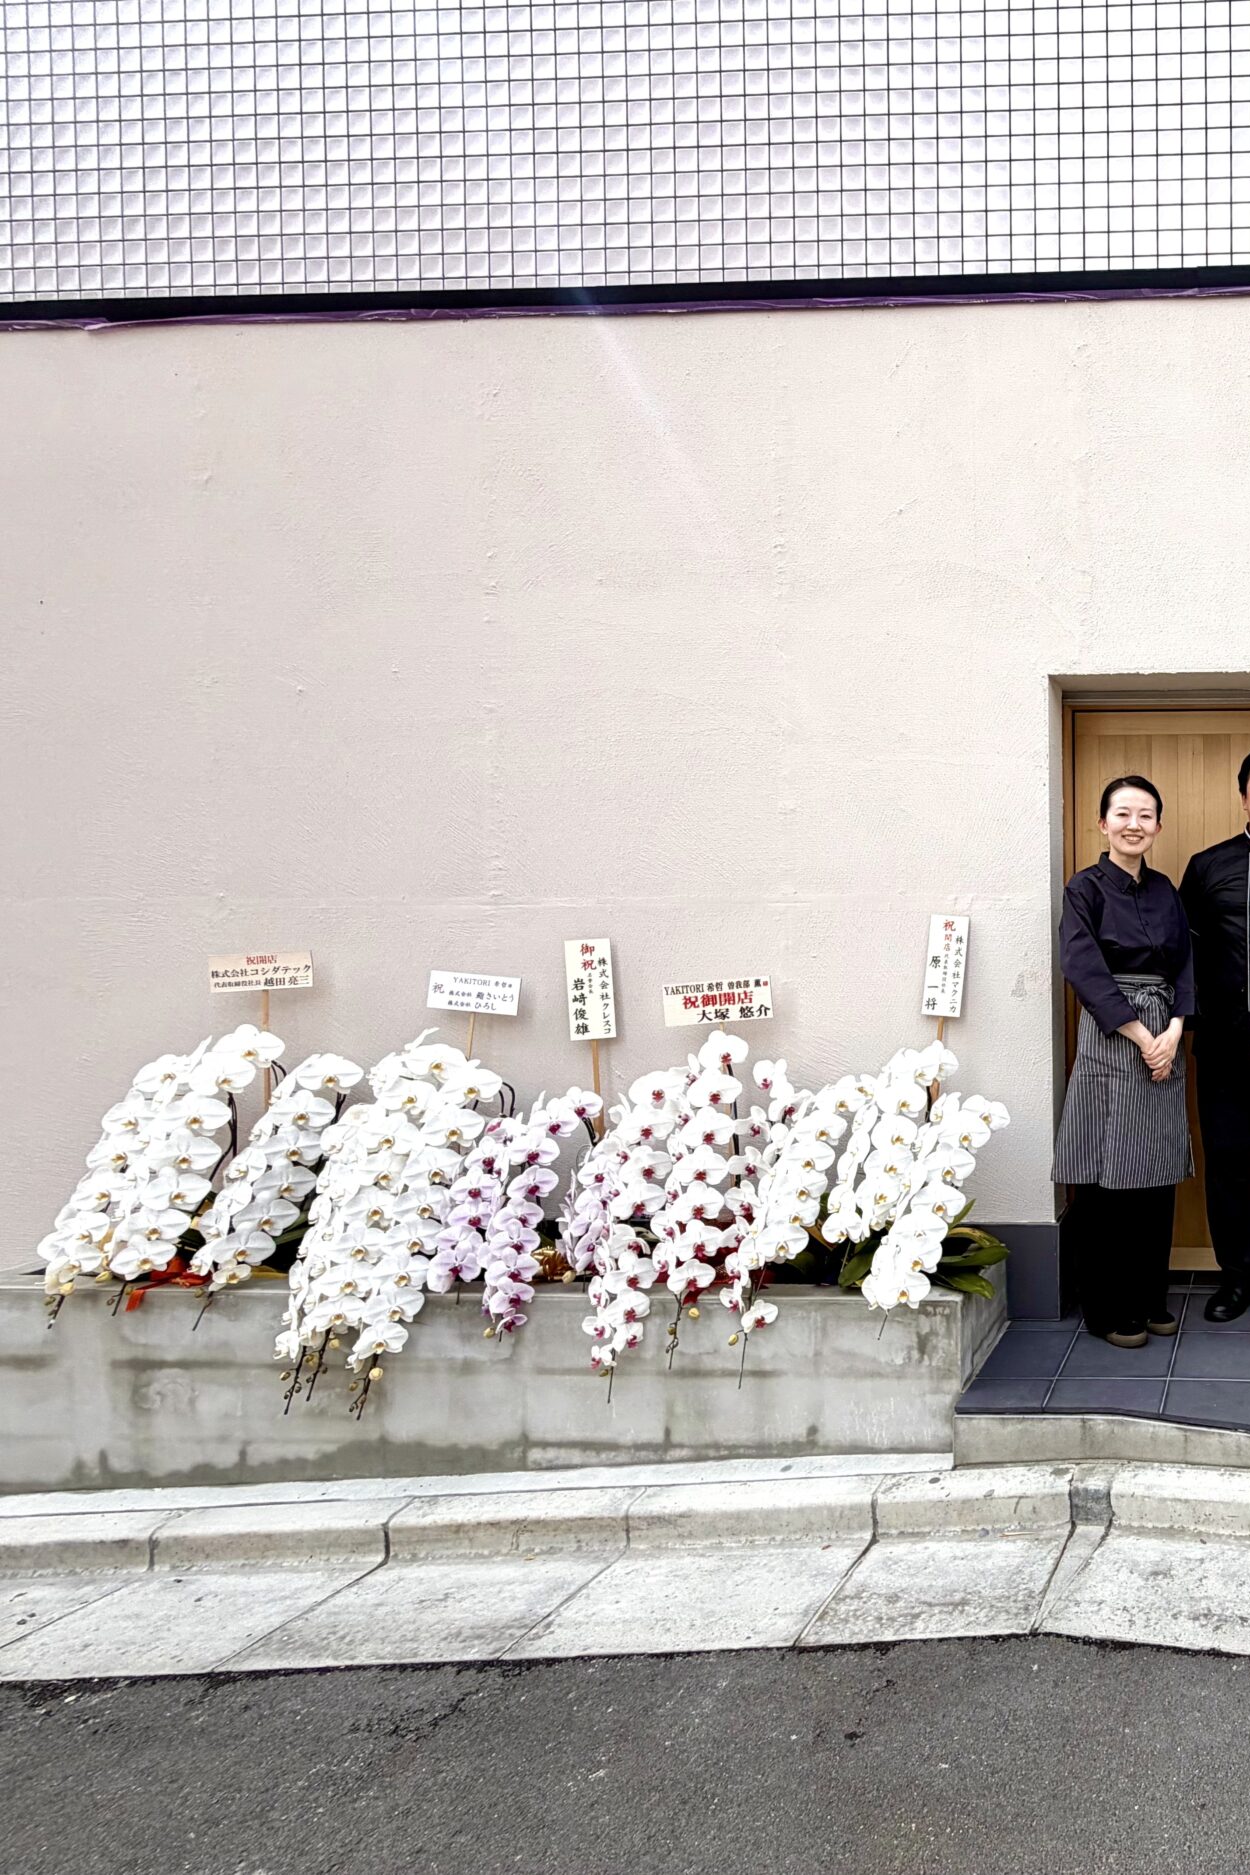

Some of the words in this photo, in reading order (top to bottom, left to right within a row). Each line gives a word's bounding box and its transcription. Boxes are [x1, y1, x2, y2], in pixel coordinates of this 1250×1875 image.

[943, 920, 956, 952] 祝開店
[246, 955, 277, 965] 祝開店
[580, 944, 597, 971] 御祝
[211, 964, 310, 978] 株式会社コシダテック
[949, 935, 964, 1013] 株式会社マクニカ
[432, 982, 445, 993] 祝
[453, 977, 490, 986] YAKITORI
[664, 984, 704, 995] YAKITORI
[598, 957, 612, 1034] 株式会社クレスコ
[682, 990, 753, 1009] 祝御開店
[475, 1002, 496, 1010] ひろし
[697, 1008, 730, 1023] 大塚
[739, 1004, 770, 1018] 悠介
